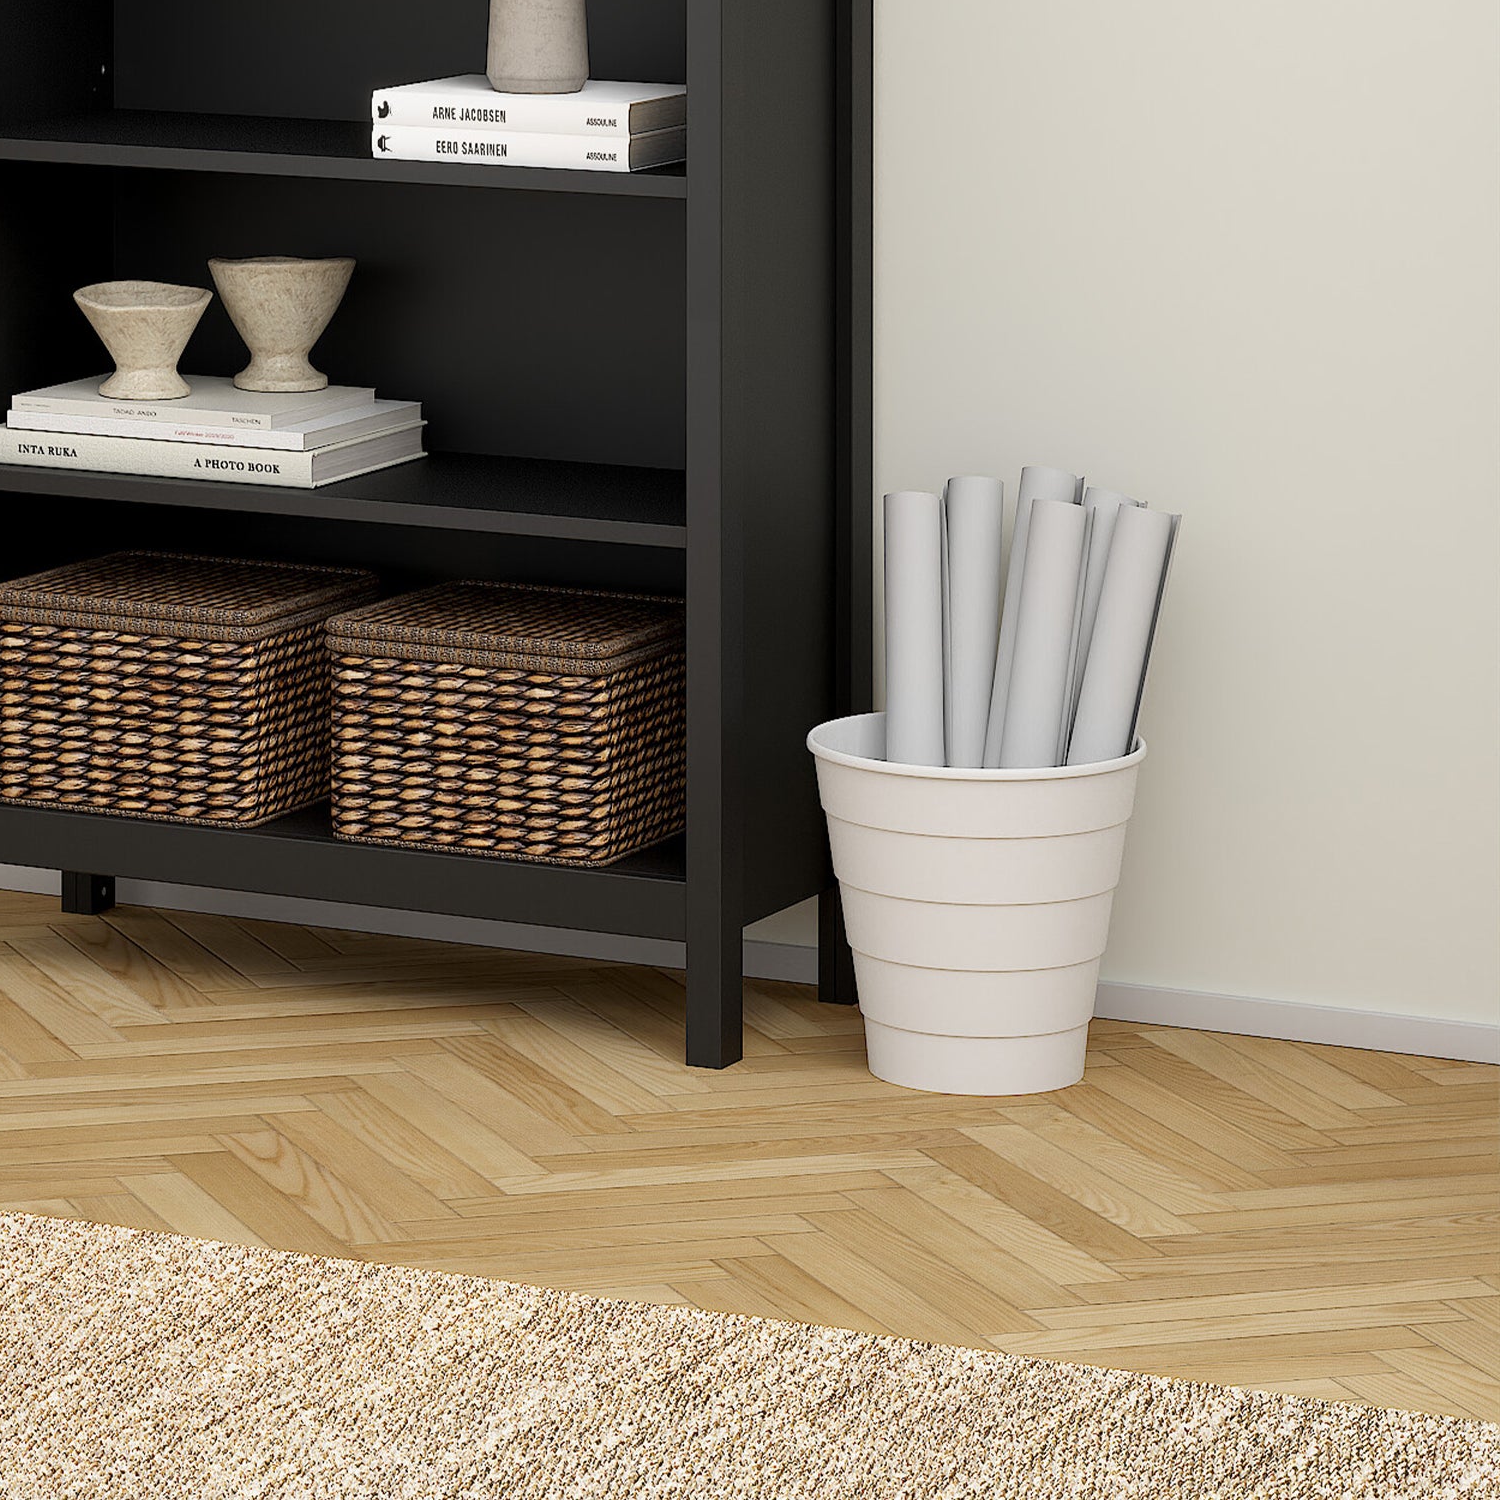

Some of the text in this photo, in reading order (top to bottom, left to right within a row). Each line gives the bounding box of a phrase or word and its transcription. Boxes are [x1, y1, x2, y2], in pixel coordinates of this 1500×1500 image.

[433, 107, 505, 123] ARNE JACOBSEN
[587, 118, 617, 127] ASSOULINE
[436, 141, 507, 157] EERO SAARINEN
[587, 152, 616, 161] ASSOULINE
[232, 417, 261, 425] TASCHEN
[19, 444, 77, 457] INTA RUKA
[194, 459, 280, 474] A PHOTO BOOK
